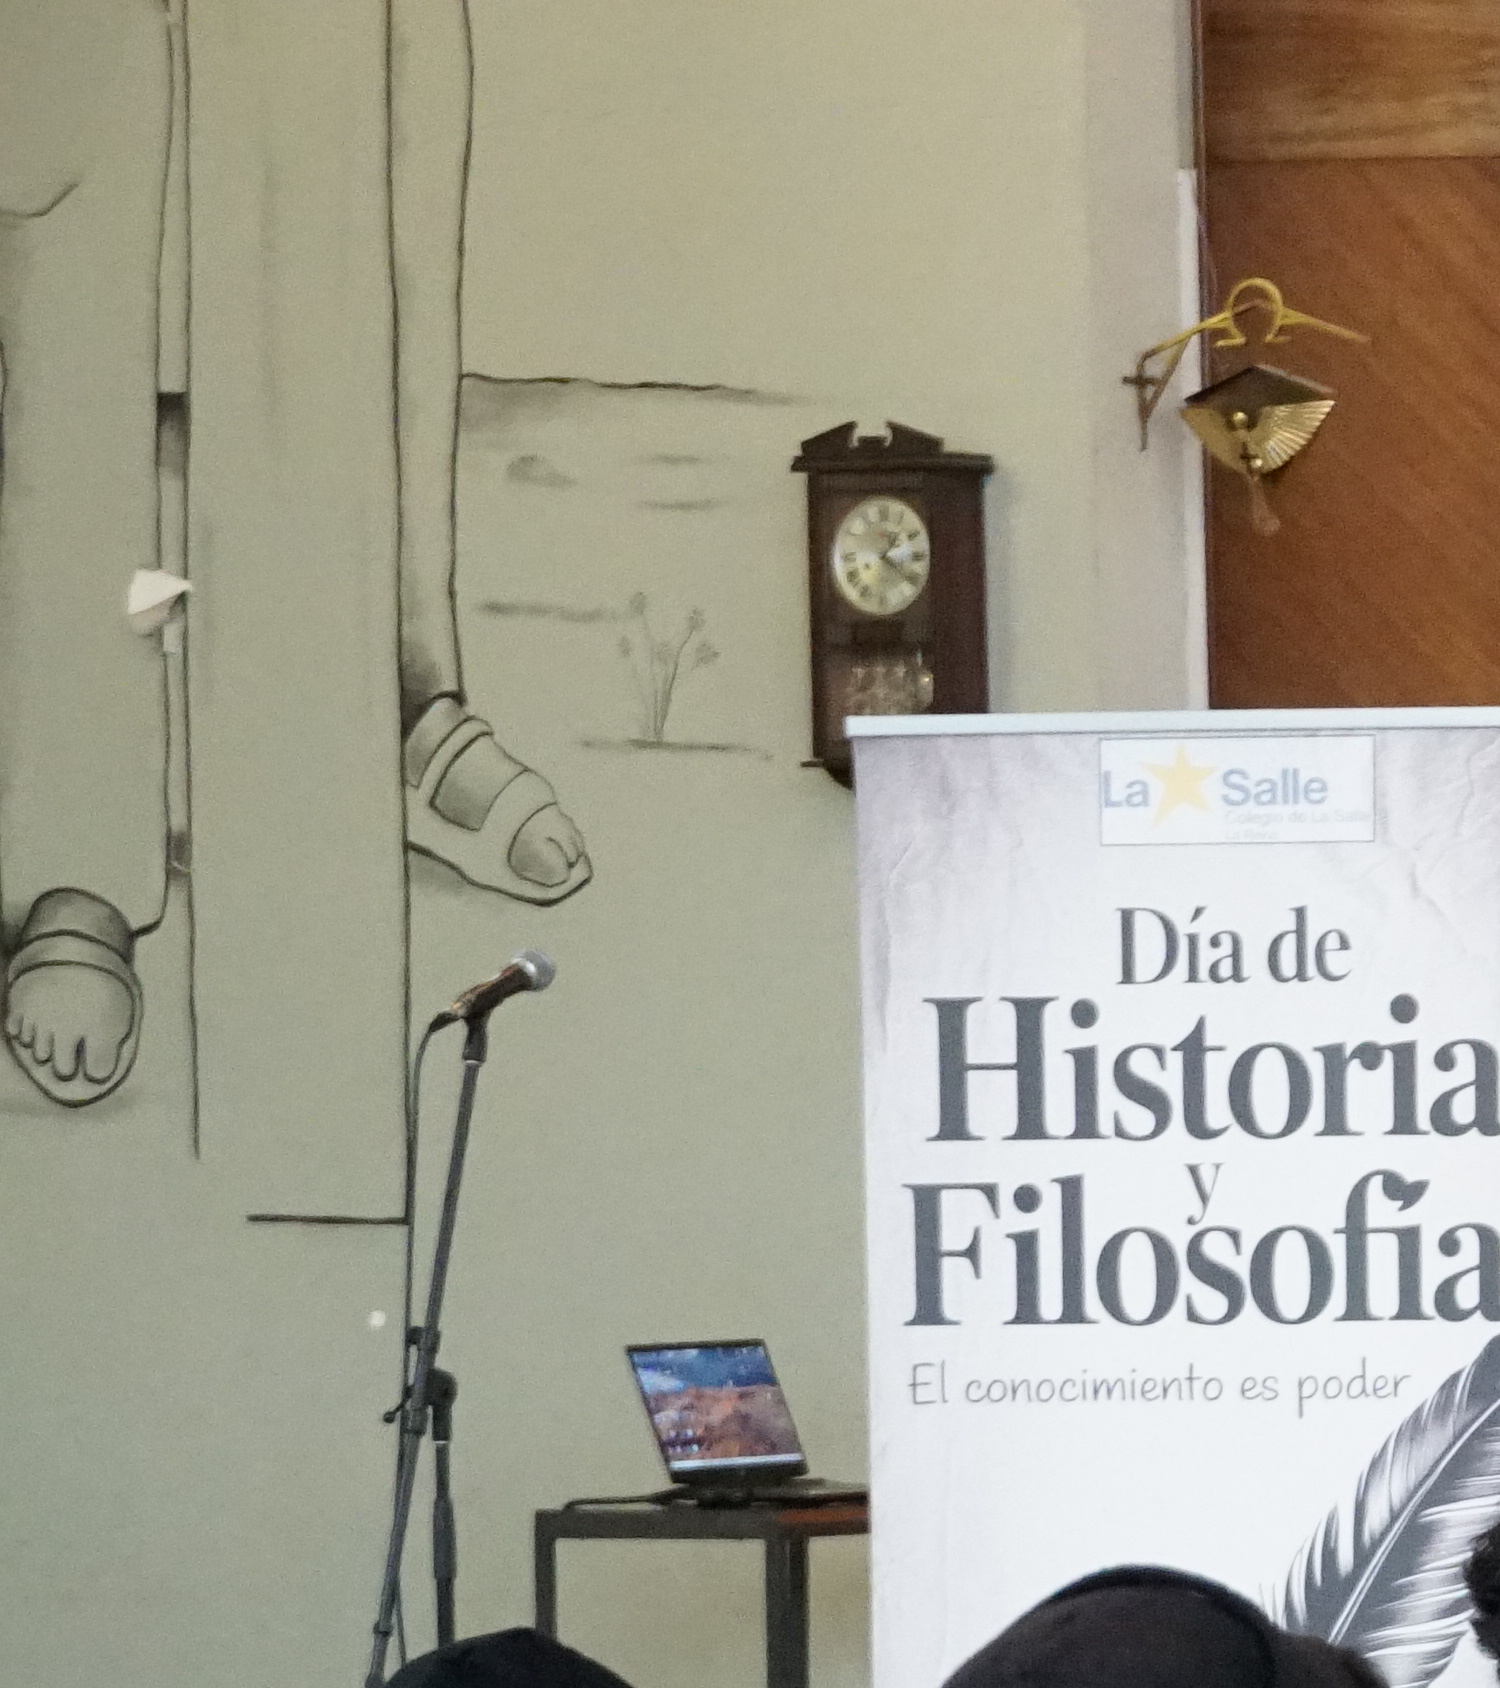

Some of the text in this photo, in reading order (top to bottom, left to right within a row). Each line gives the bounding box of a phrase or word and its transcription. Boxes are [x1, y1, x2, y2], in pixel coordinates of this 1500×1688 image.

[1102, 767, 1329, 809] La Salle
[1116, 905, 1352, 985] Día de
[1186, 1163, 1222, 1225] y
[908, 1357, 1412, 1418] El conocimiento es poder
